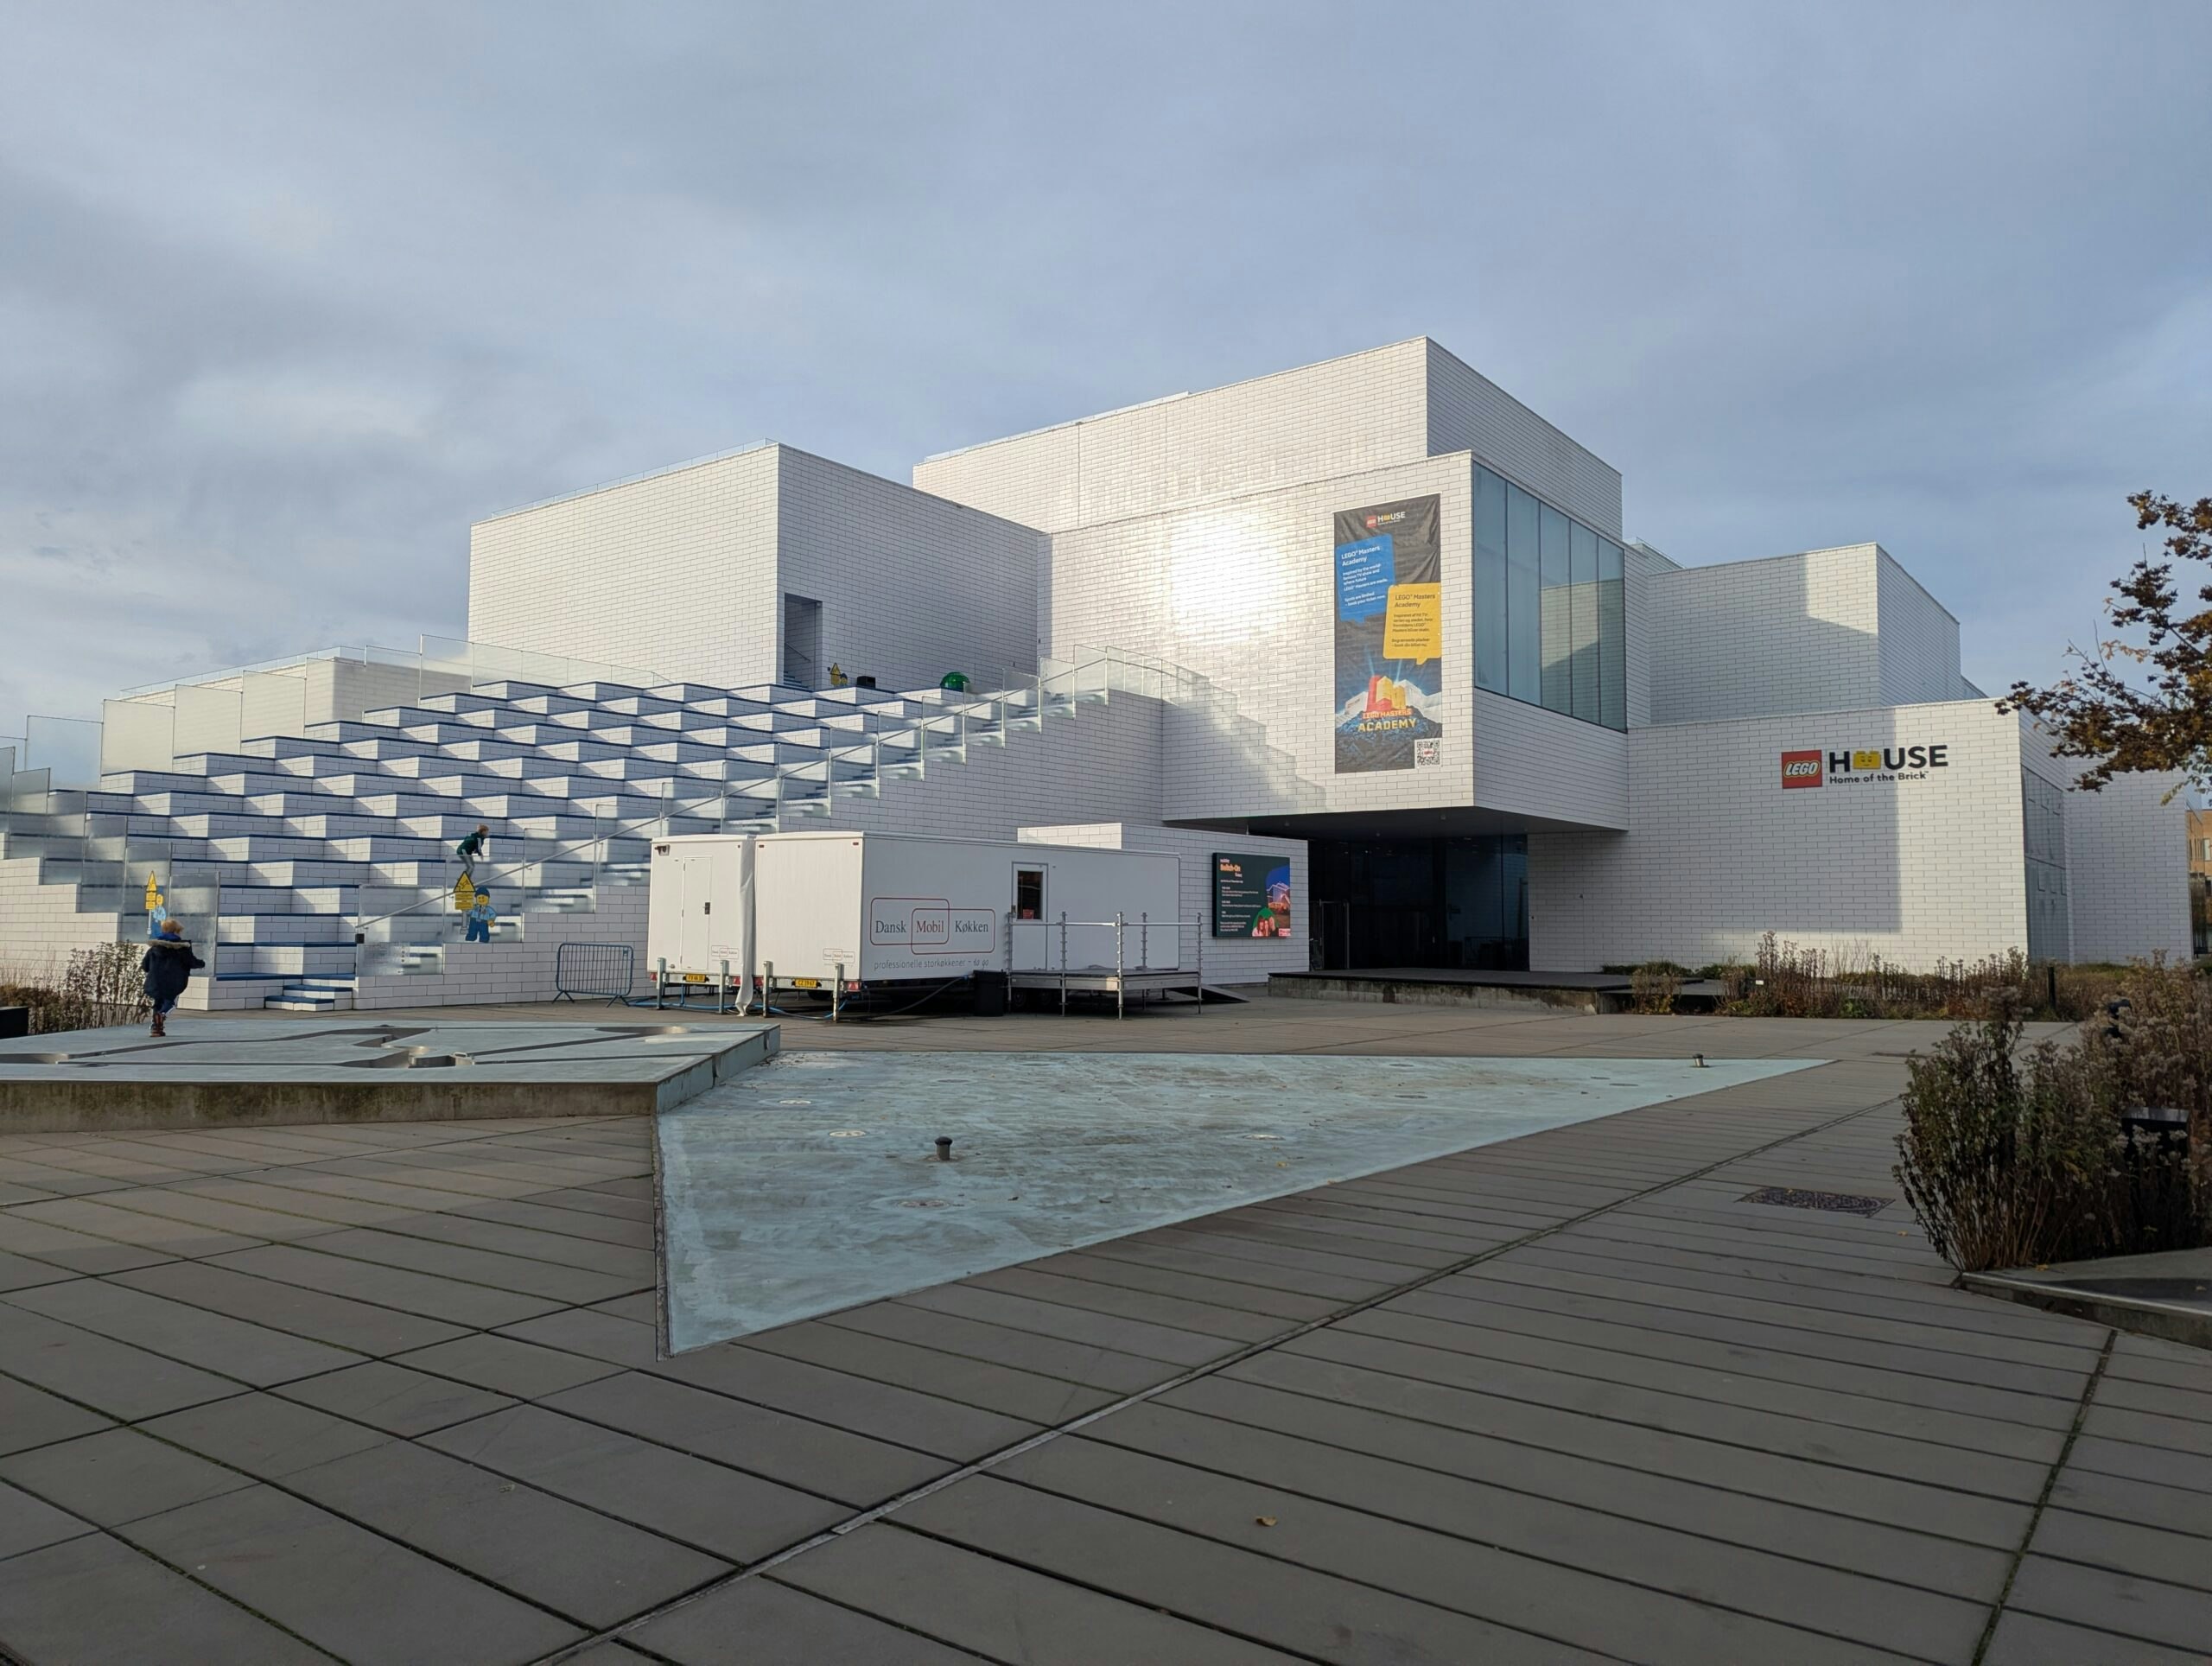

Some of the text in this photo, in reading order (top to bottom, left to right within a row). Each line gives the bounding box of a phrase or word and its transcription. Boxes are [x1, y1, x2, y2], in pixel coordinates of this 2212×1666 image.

[1358, 546, 1380, 556] Masters
[1342, 556, 1367, 566] Academy
[1357, 718, 1417, 733] ACADEMY
[1784, 761, 1821, 777] LEGO
[1829, 774, 1859, 785] Home
[1863, 773, 1875, 783] of
[1878, 771, 1895, 782] the
[875, 919, 988, 934] Dansk Mobil Køkken
[874, 959, 923, 970] professionelle
[924, 958, 966, 968] storkøkkener
[973, 958, 980, 967] to
